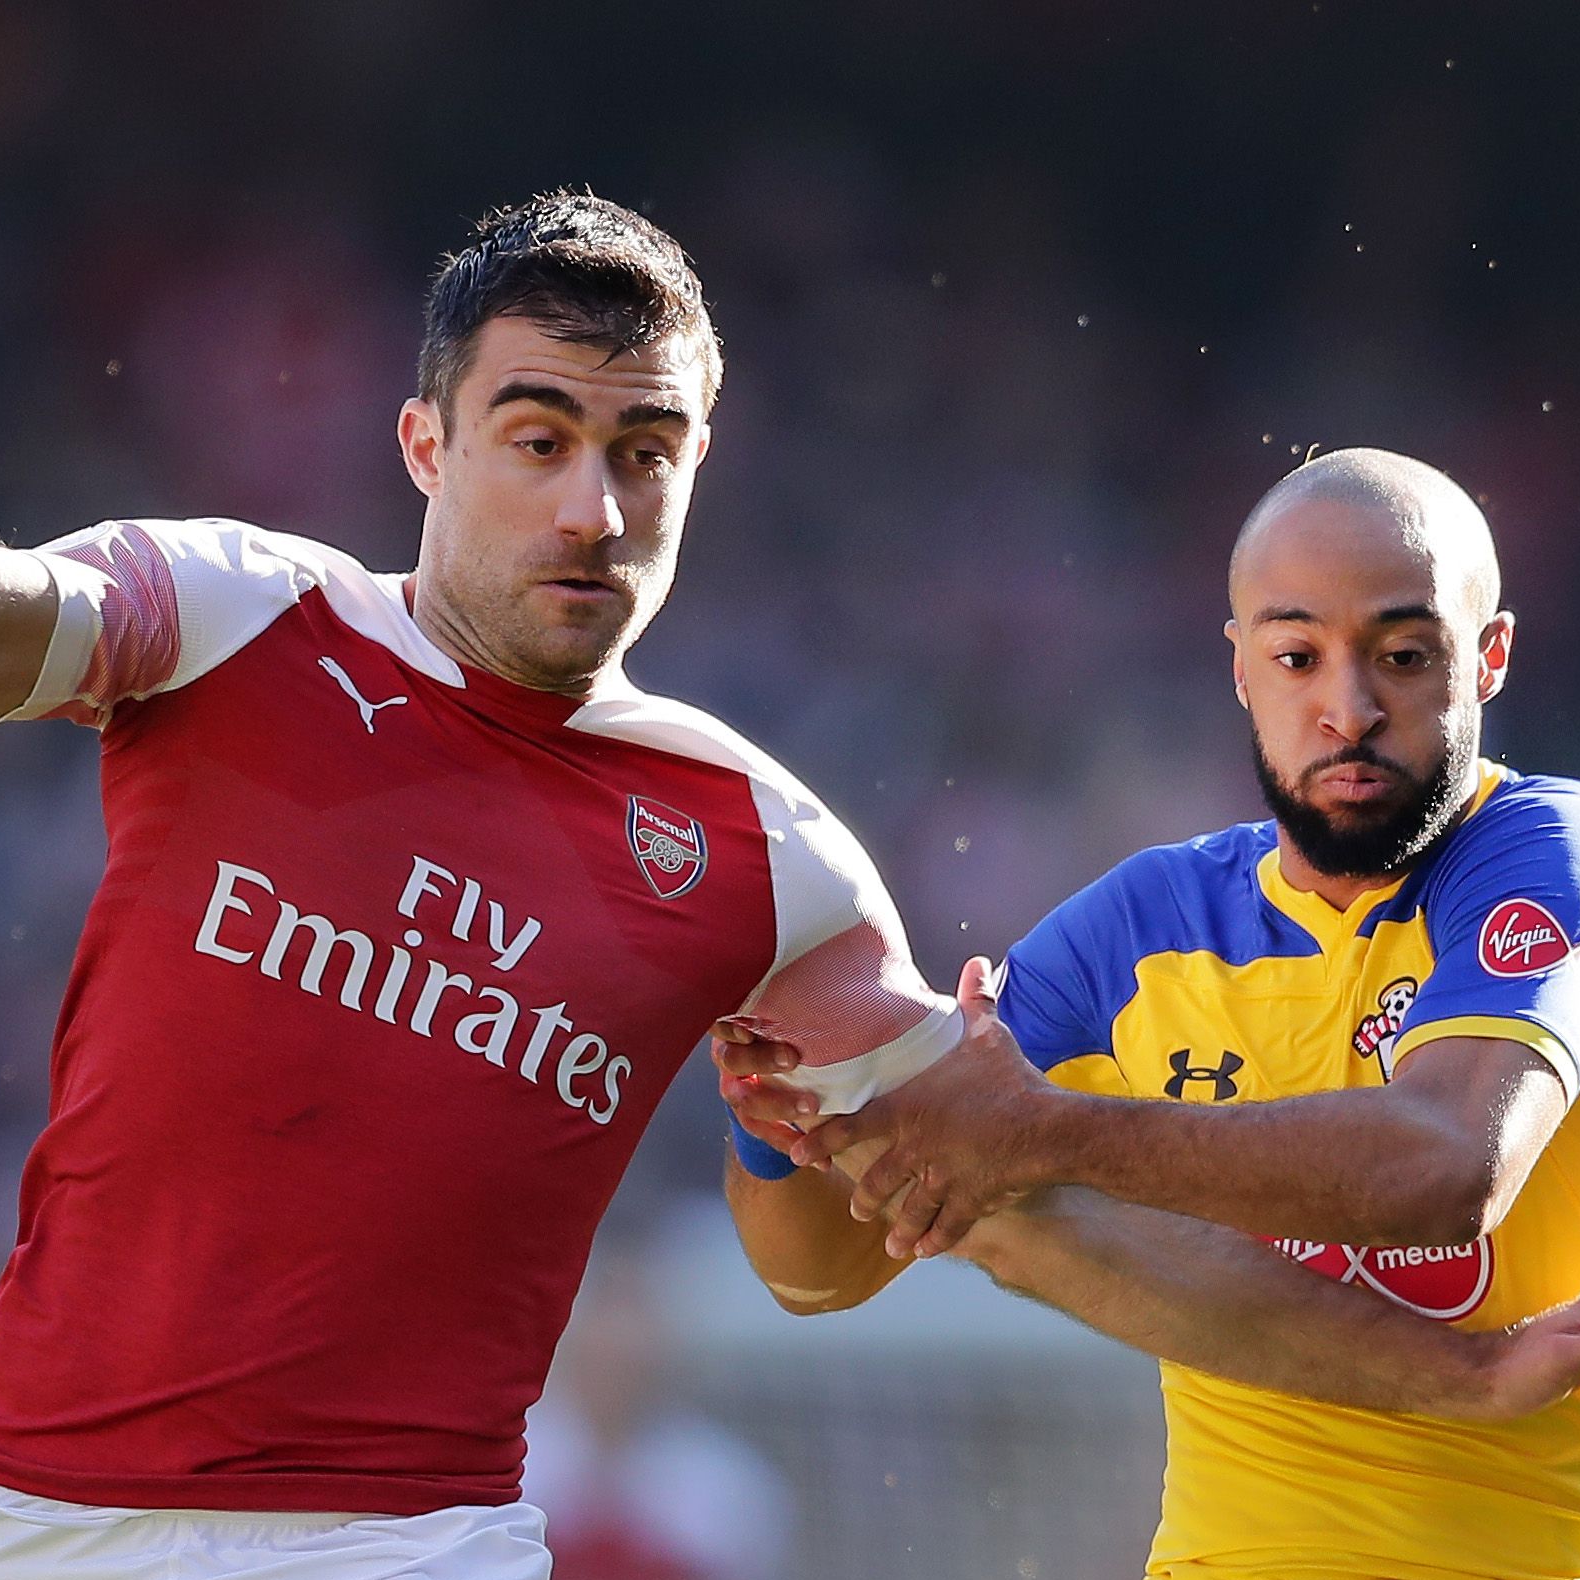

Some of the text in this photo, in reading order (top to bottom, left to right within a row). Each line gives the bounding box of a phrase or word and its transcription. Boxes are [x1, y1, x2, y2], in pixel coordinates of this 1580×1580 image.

[638, 806, 694, 843] Arsenal
[397, 855, 542, 971] Fly
[1488, 911, 1557, 965] Virgin
[194, 860, 632, 1125] Emirates
